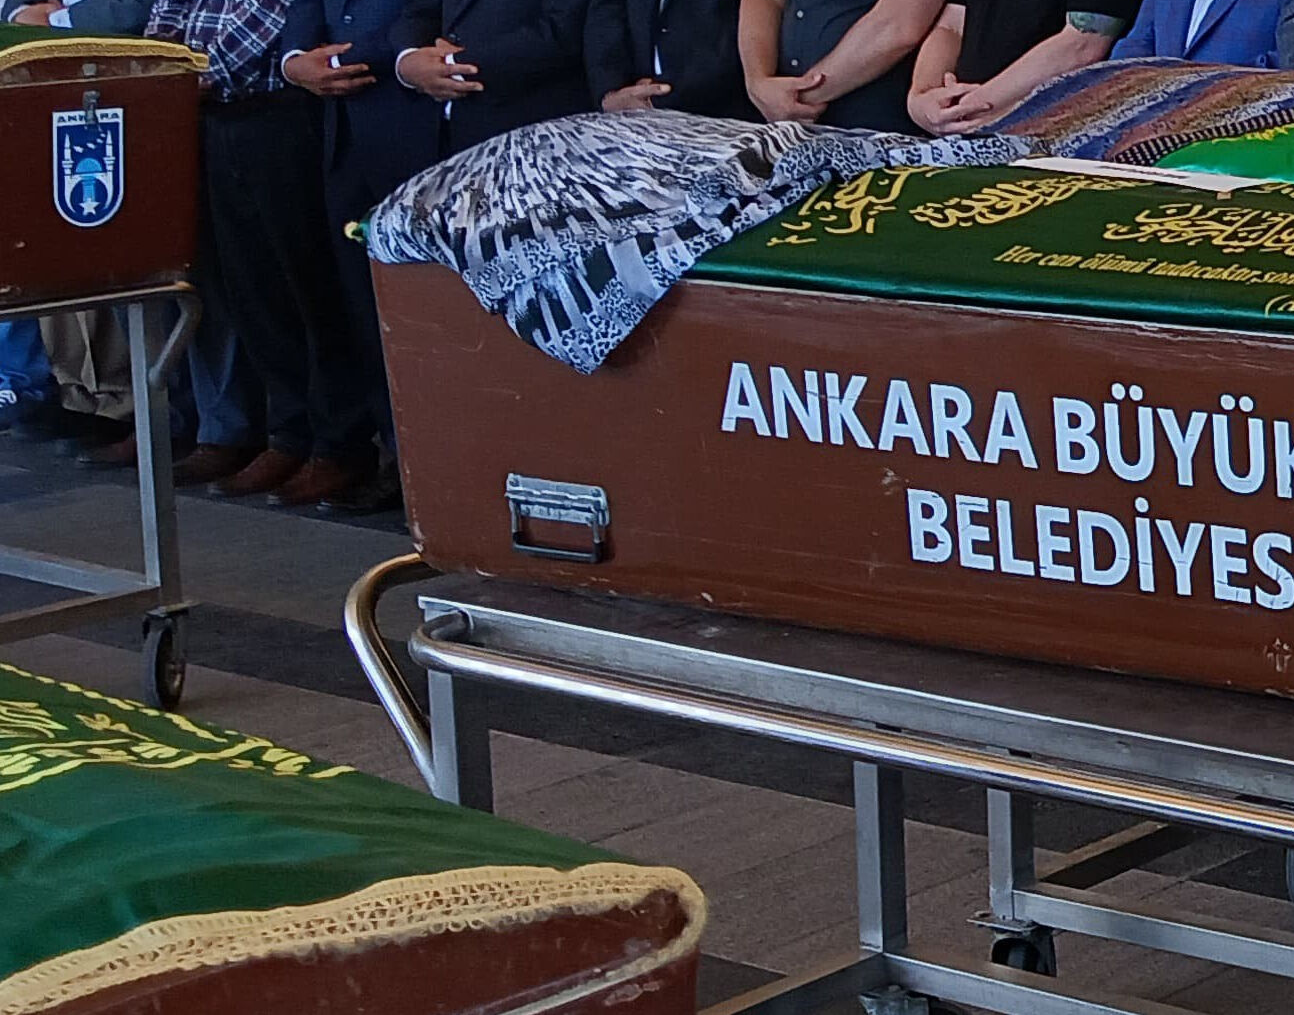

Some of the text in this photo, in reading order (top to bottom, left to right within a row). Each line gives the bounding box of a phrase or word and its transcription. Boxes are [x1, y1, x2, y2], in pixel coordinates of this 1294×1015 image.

[57, 112, 120, 123] ANKRA
[993, 245, 1042, 263] Her
[1038, 253, 1083, 268] can
[721, 361, 1038, 469] ANKARA
